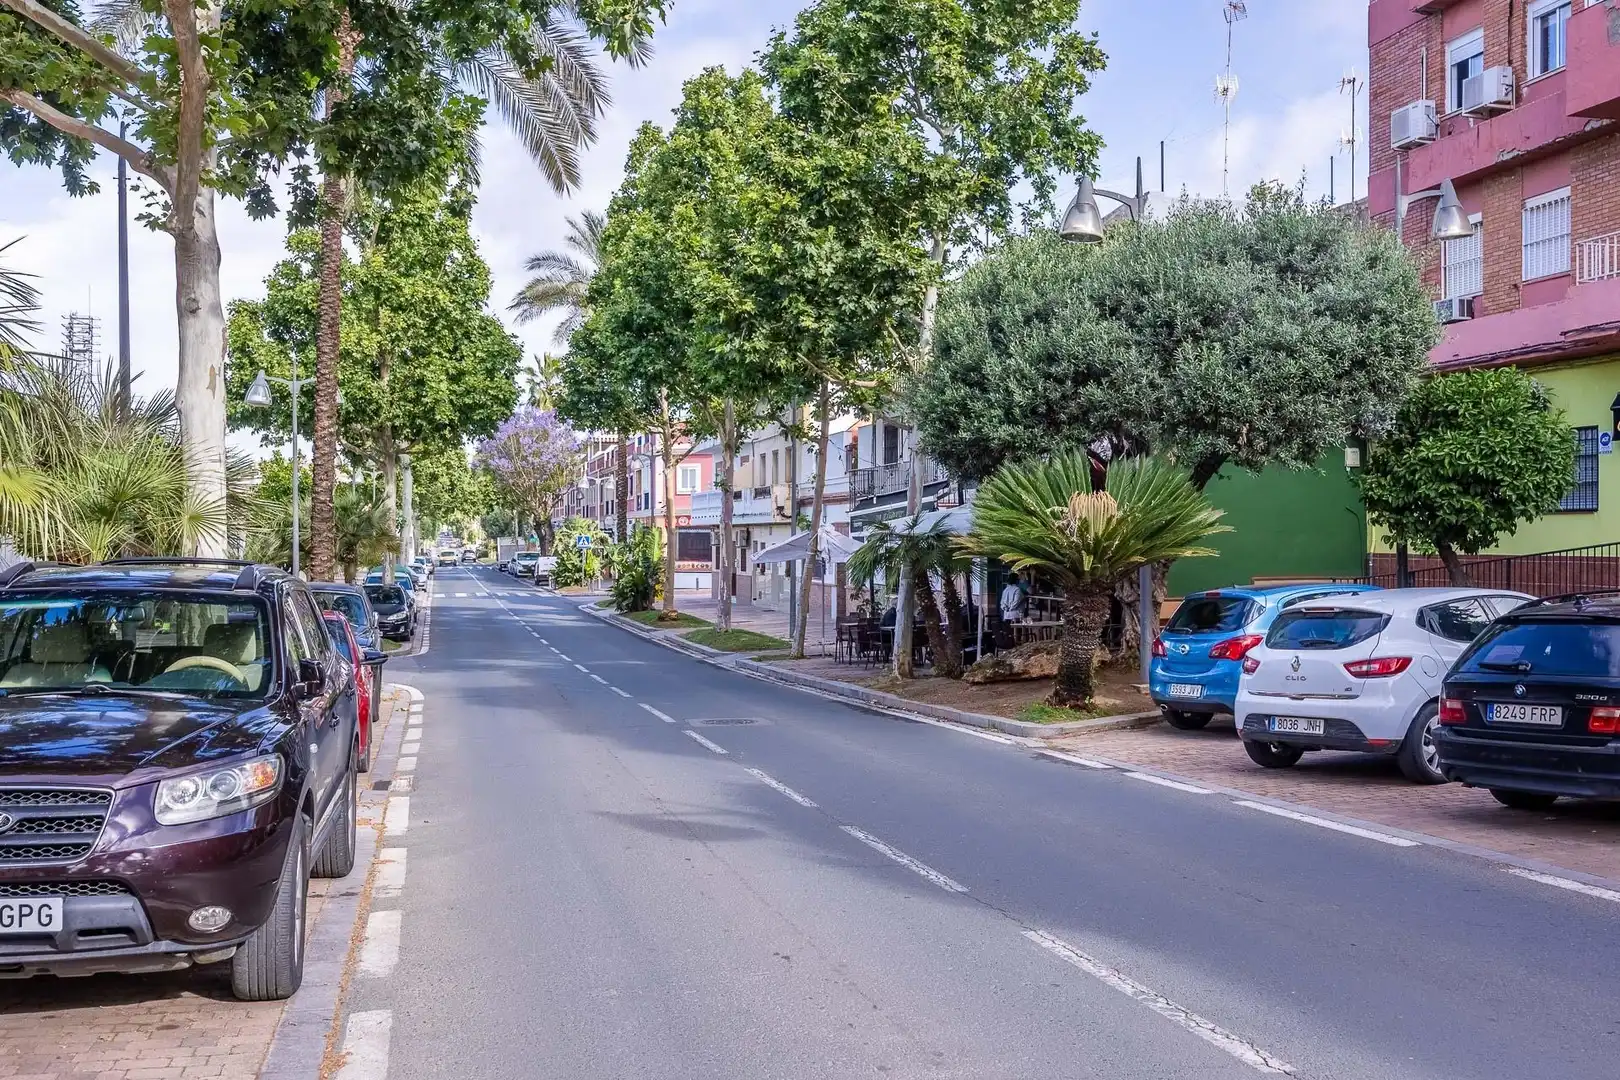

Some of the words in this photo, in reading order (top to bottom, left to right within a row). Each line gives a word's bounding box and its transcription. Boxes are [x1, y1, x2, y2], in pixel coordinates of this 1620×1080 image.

[1171, 684, 1186, 694] 3593
[1574, 693, 1608, 701] 320d
[1494, 705, 1527, 720] 8249
[1530, 706, 1557, 722] FRP
[1277, 718, 1299, 731] 8036
[1303, 719, 1322, 732] JNH
[0, 904, 53, 928] GPG
